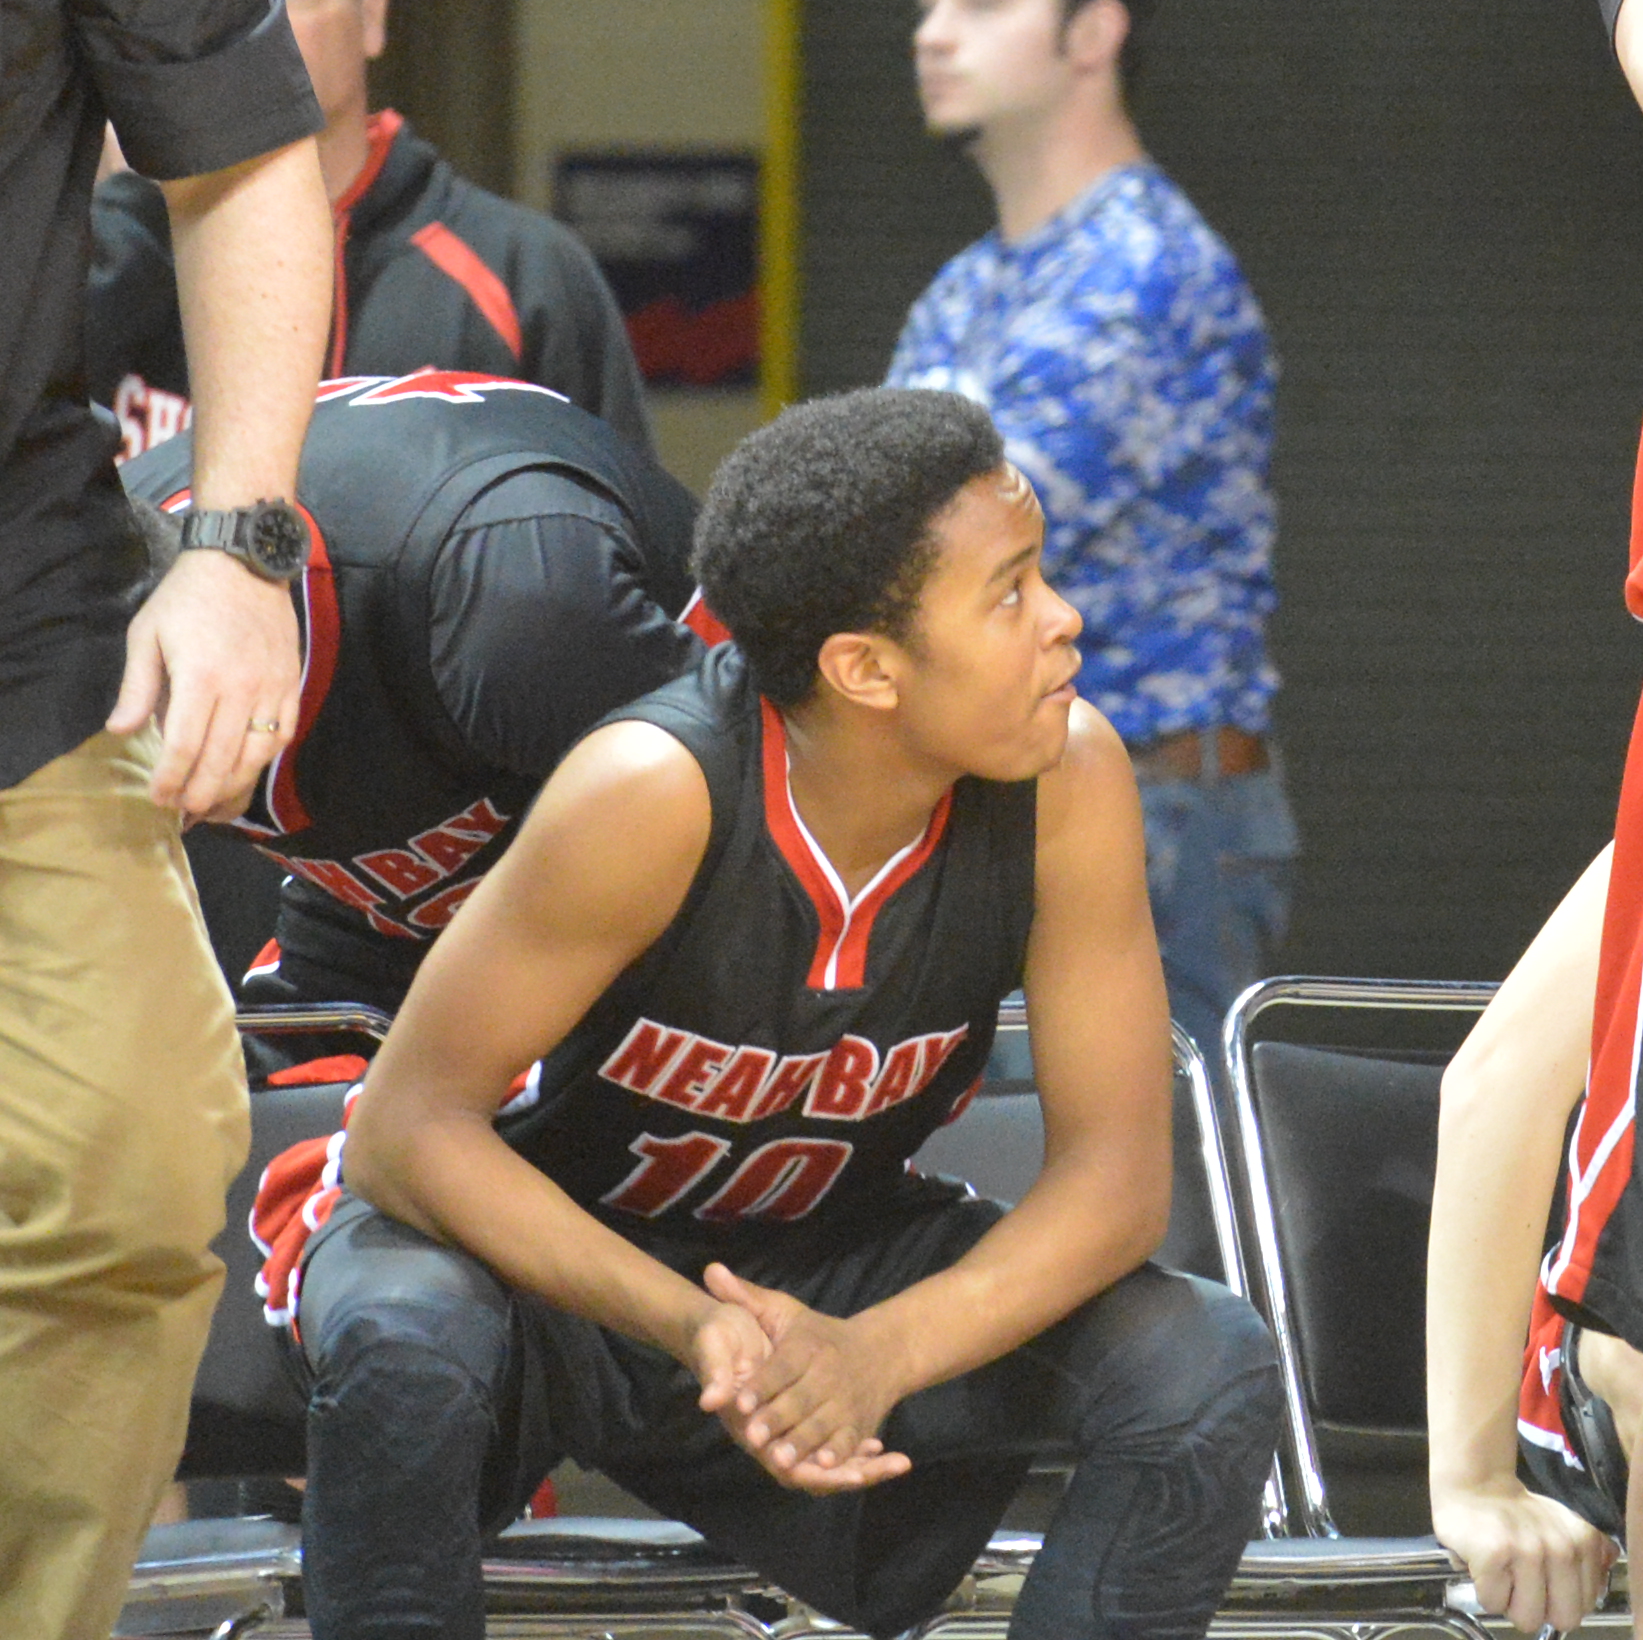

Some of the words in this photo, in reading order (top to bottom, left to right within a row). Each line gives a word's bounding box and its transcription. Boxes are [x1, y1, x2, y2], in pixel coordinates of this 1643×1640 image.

[598, 1016, 831, 1123] NEAH
[802, 1033, 969, 1122] BAY
[599, 1130, 853, 1222] 10
